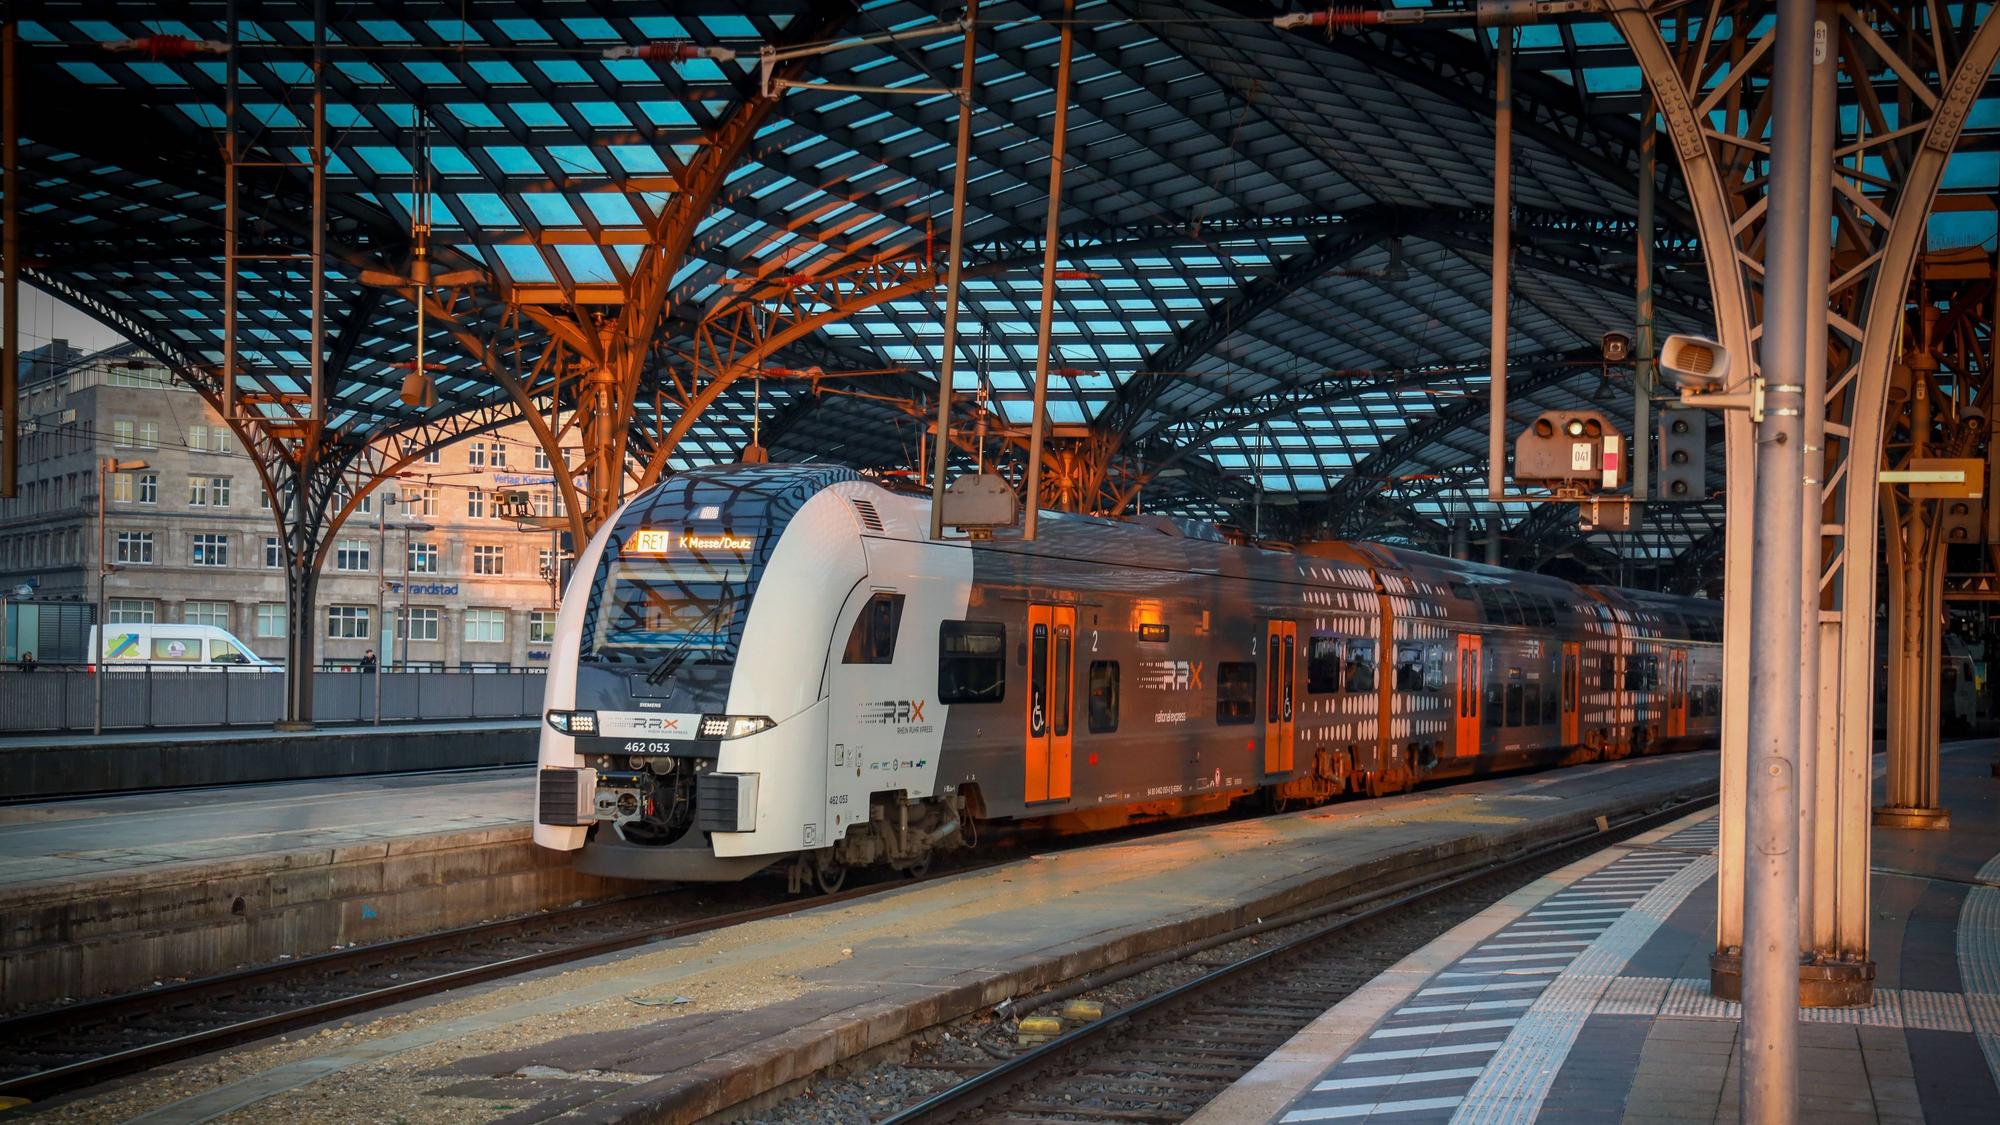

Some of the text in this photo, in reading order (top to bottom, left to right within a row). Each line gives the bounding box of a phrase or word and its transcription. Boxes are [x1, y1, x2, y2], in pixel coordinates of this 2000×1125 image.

[1575, 451, 1589, 462] 041
[493, 473, 520, 485] Verlag
[642, 533, 664, 550] RE1
[679, 536, 751, 549] K Messe/Deutz
[409, 582, 459, 596] randstad
[1091, 630, 1098, 652] 2
[1252, 636, 1257, 656] 2
[1160, 661, 1204, 691] RRX
[881, 699, 925, 724] RRX
[632, 717, 679, 730] RRX
[624, 742, 671, 753] 462 053
[829, 795, 839, 805] 462
